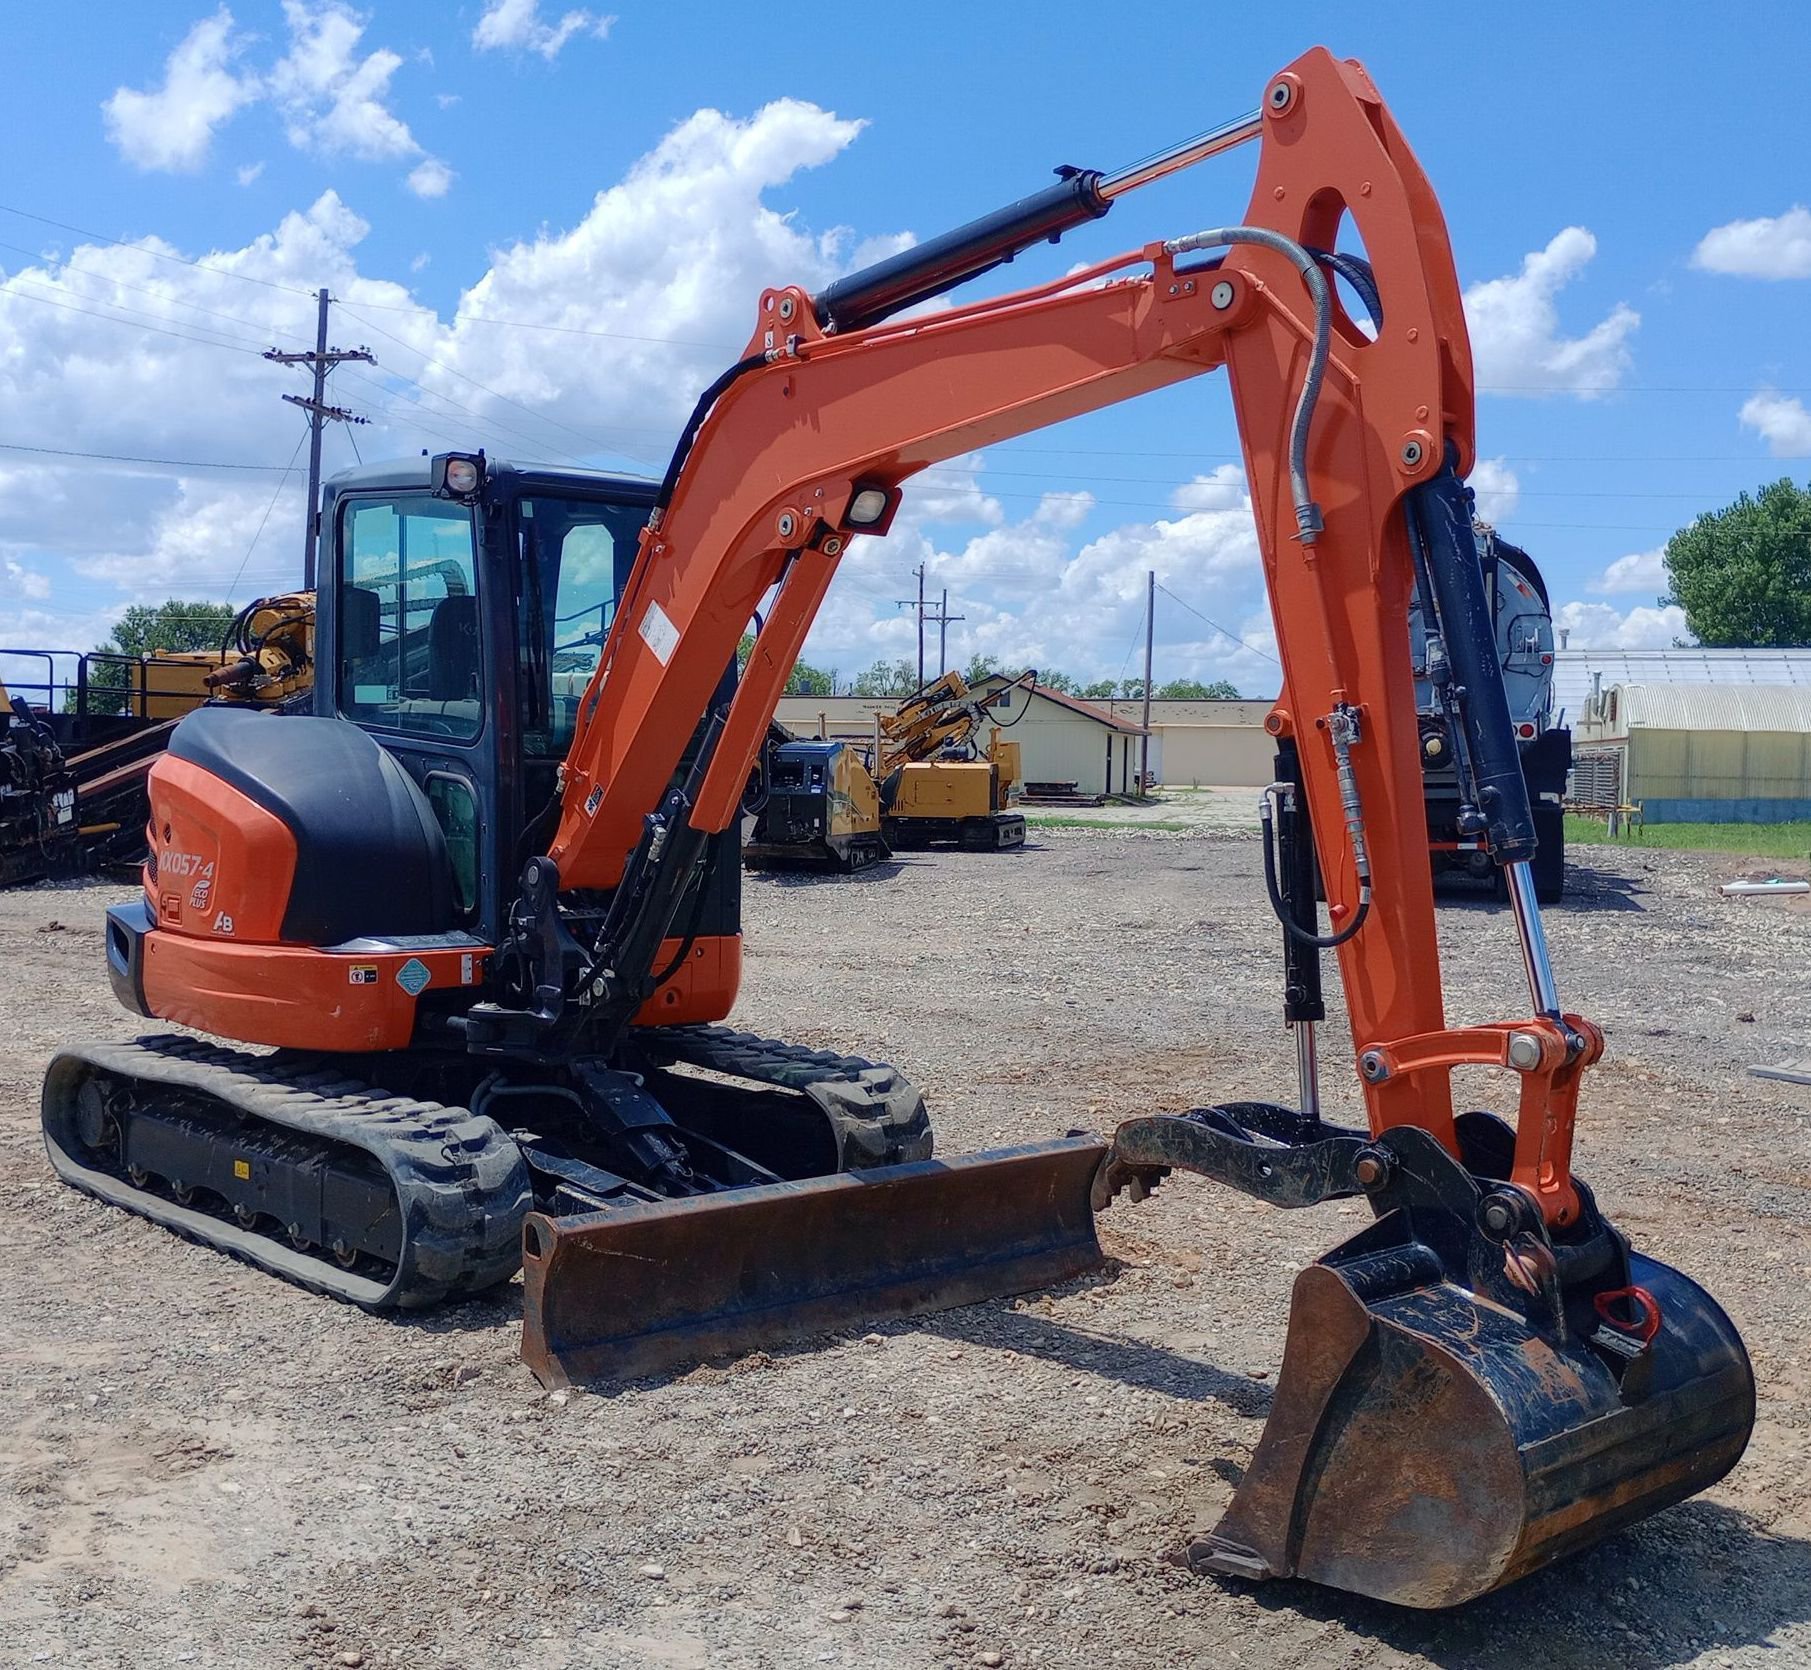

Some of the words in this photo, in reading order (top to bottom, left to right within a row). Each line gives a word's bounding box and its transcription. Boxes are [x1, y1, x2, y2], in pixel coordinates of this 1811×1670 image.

[194, 888, 209, 899] ECO
[189, 896, 207, 909] PLUS
[212, 911, 234, 932] AB
